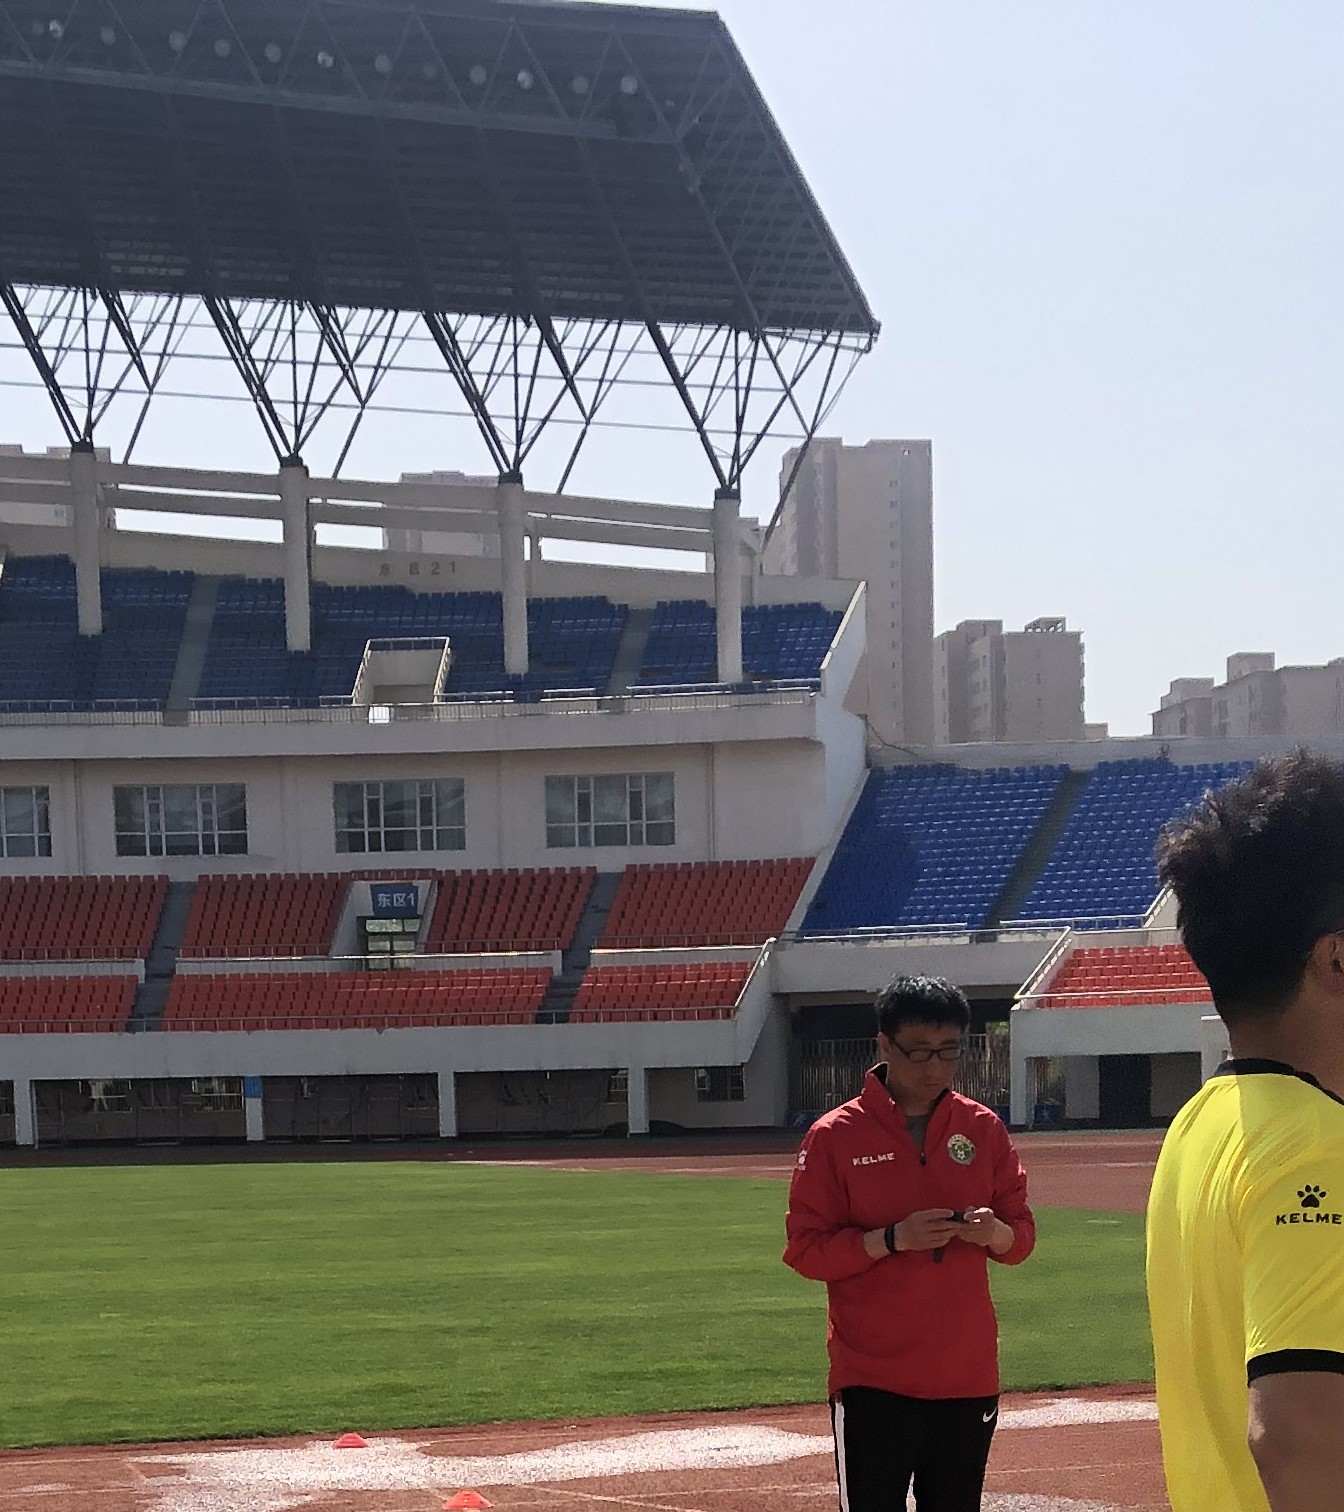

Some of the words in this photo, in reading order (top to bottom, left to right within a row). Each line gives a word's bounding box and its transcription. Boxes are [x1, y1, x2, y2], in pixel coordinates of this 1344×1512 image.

[376, 892, 415, 908] 东区1
[852, 1152, 896, 1166] KELME
[1275, 1212, 1343, 1226] KELME
